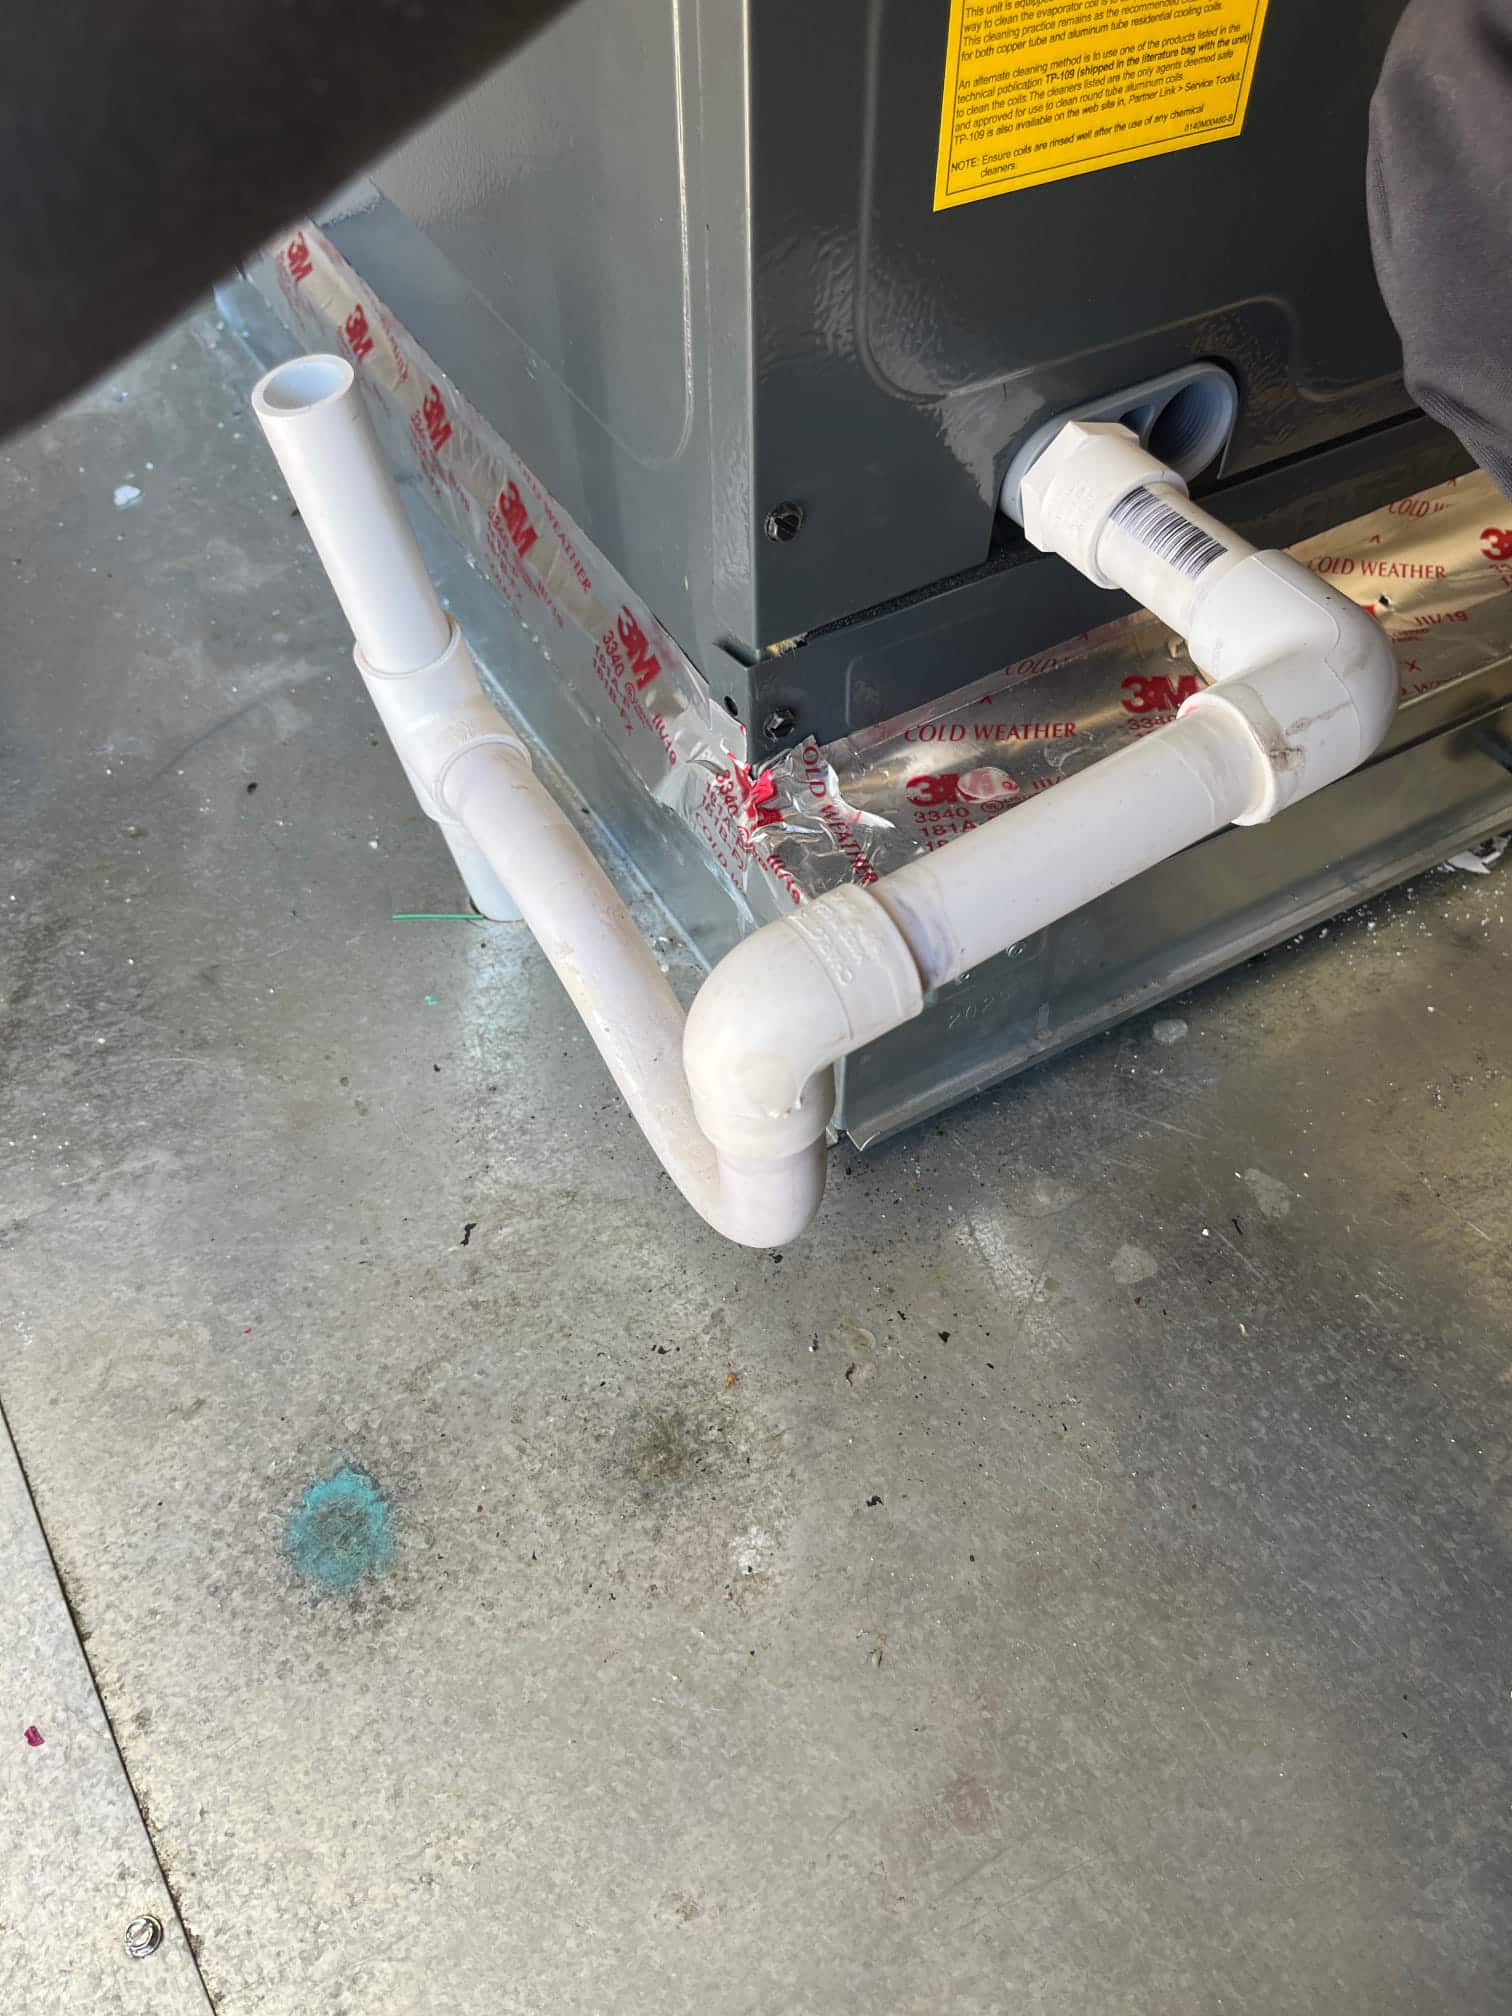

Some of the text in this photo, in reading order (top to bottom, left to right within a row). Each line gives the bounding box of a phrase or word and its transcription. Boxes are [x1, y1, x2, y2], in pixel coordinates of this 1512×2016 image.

[963, 22, 981, 32] way
[994, 15, 1018, 26] clean
[1020, 11, 1034, 21] the
[1035, 3, 1082, 18] evaporator
[1083, 0, 1099, 8] coil
[964, 35, 981, 46] This
[983, 28, 1019, 42] cleaning
[1021, 21, 1055, 37] practice
[1058, 14, 1092, 27] remains
[1105, 8, 1119, 18] the
[966, 5, 984, 17] This
[986, 1, 1002, 14] unit
[975, 45, 994, 57] both
[996, 41, 1025, 54] copper
[1028, 35, 1047, 47] tube
[1048, 31, 1065, 43] and
[1067, 24, 1109, 39] aluminum
[1110, 19, 1128, 30] tube
[1131, 10, 1172, 26] residential
[1173, 5, 1202, 18] cooling
[957, 86, 995, 103] technical
[996, 78, 1042, 96] publication
[1044, 69, 1074, 84] TP-109
[1076, 61, 1114, 79] (shipped
[1126, 56, 1139, 67] the
[1141, 49, 1179, 63] literature
[1180, 46, 1196, 55] bag
[1197, 39, 1215, 51] with
[1216, 37, 1230, 47] the
[958, 79, 971, 89] An
[1012, 63, 1047, 78] cleaning
[1049, 55, 1081, 70] method
[1102, 49, 1117, 59] use
[1119, 46, 1135, 55] one
[1146, 39, 1160, 49] the
[1160, 32, 1195, 48] products
[1197, 26, 1217, 39] listed
[1228, 22, 1241, 32] the
[955, 118, 971, 131] and
[973, 109, 1012, 128] approved
[1028, 104, 1043, 114] use
[1055, 97, 1077, 108] clean
[1079, 89, 1103, 103] round
[1104, 86, 1123, 97] tube
[1125, 78, 1164, 92] aluminum
[966, 103, 990, 115] clean
[992, 99, 1005, 109] the
[1028, 90, 1044, 101] The
[1046, 83, 1082, 97] cleaners
[1083, 76, 1105, 89] listed
[1107, 75, 1120, 84] are
[1122, 70, 1135, 81] the
[1136, 66, 1153, 78] only
[1154, 60, 1181, 74] agents
[1183, 52, 1216, 67] deemed
[1217, 49, 1234, 60] safe
[954, 129, 984, 144] TP-109
[995, 124, 1013, 135] also
[1015, 114, 1052, 130] available
[1066, 108, 1079, 119] the
[1081, 103, 1098, 115] web
[1100, 100, 1115, 111] site
[1127, 92, 1158, 105] Partner
[1159, 85, 1176, 97] Link
[1184, 79, 1214, 92] Service
[981, 151, 1010, 165] Ensure
[1012, 144, 1032, 157] coils
[1034, 142, 1047, 152] are
[1048, 134, 1074, 149] rinsed
[1075, 130, 1091, 142] well
[1093, 126, 1112, 138] after
[1113, 122, 1126, 133] the
[1127, 120, 1142, 130] use
[1154, 114, 1168, 124] any
[1169, 103, 1204, 120] chemical
[287, 231, 313, 282] 3M
[345, 304, 374, 359] 3M
[422, 384, 452, 452] 3M
[499, 480, 538, 558] 3M
[1480, 527, 1512, 561] 3
[1360, 560, 1447, 579] WEATHER
[603, 629, 625, 677] 3340
[617, 605, 662, 691] 3M
[1120, 675, 1199, 713] 3M
[903, 721, 1077, 743] COLD WEATHER
[716, 768, 738, 816] 3340
[803, 746, 827, 798] OLD
[913, 807, 970, 823] 3340
